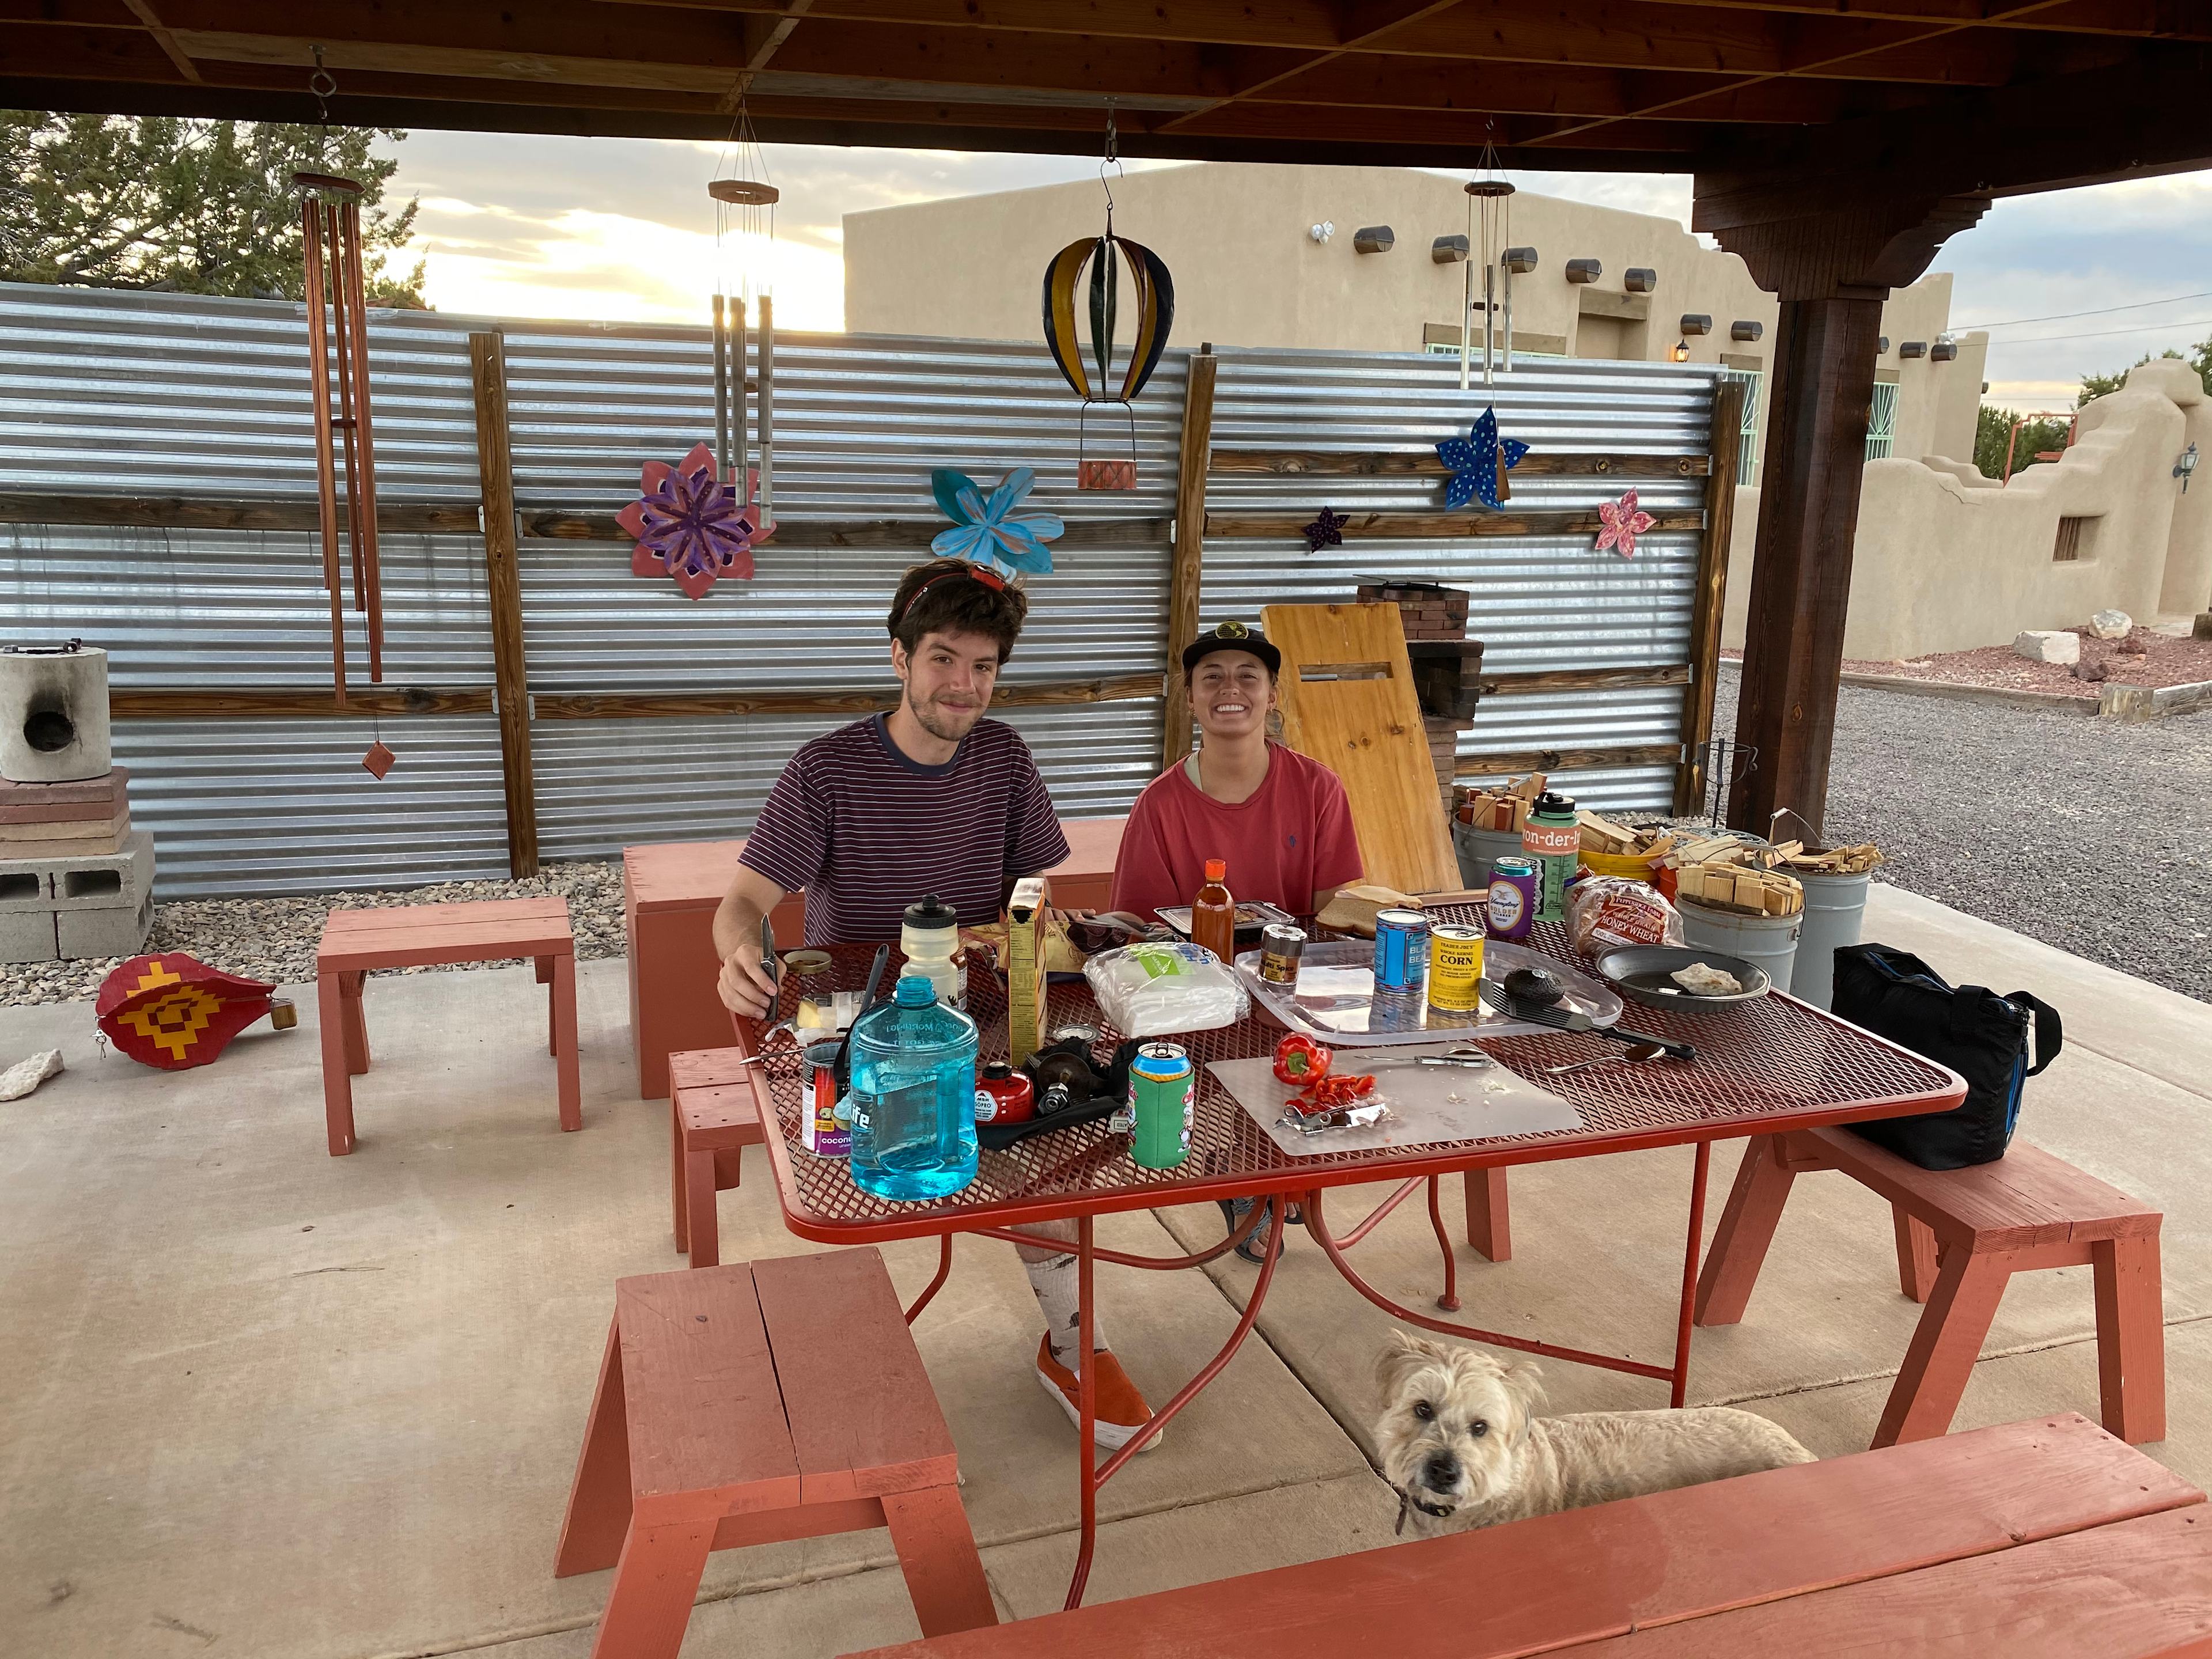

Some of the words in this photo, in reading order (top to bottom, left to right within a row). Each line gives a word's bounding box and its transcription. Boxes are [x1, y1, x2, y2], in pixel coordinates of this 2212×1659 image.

[1490, 895, 1520, 908] Yuengling
[1616, 897, 1647, 910] PEPPERIDGE
[1647, 905, 1661, 918] FARM
[1490, 905, 1517, 915] GOLDEN
[1613, 911, 1635, 922] WHOLE
[1635, 919, 1656, 931] GRAIN
[1600, 915, 1630, 931] HONEY
[1630, 923, 1660, 944] WHEAT
[1410, 945, 1425, 955] BLA
[1409, 955, 1425, 964] BEA
[1440, 955, 1473, 965] CORN
[851, 1103, 870, 1129] ife
